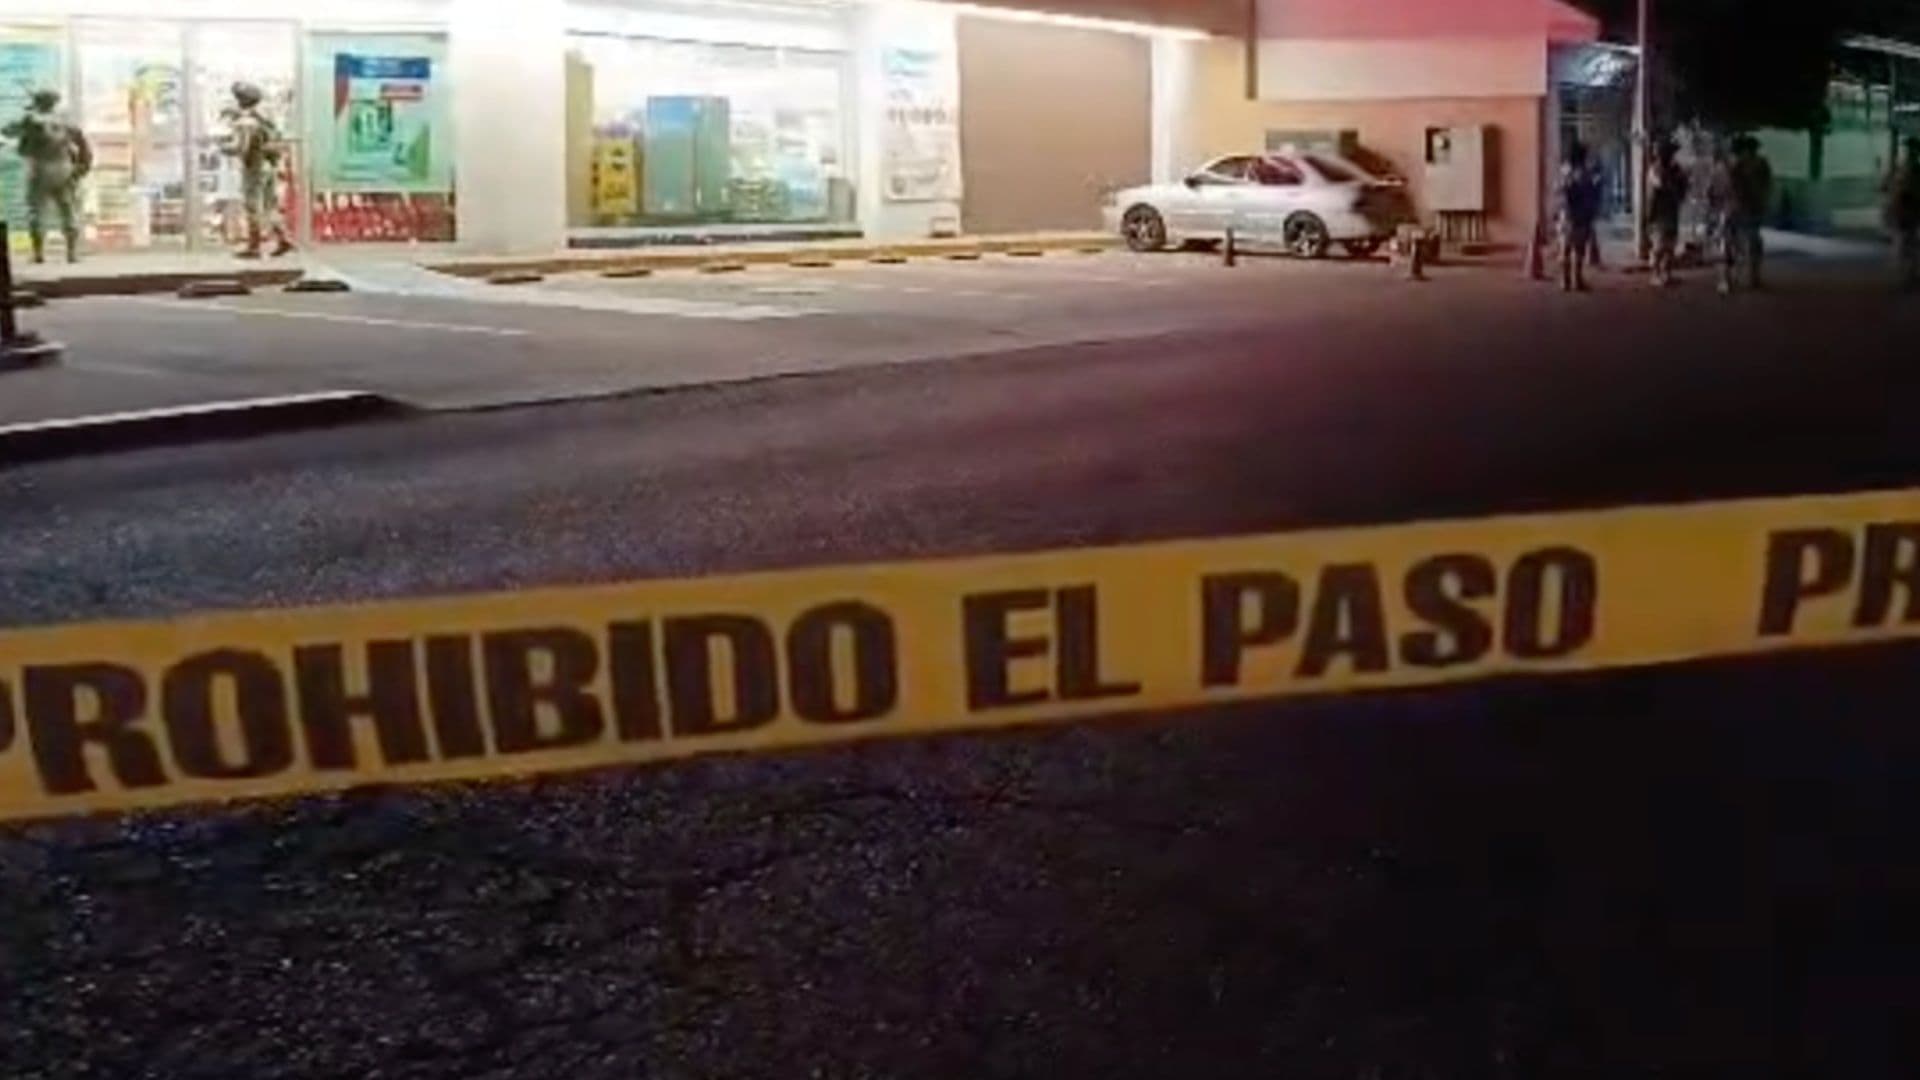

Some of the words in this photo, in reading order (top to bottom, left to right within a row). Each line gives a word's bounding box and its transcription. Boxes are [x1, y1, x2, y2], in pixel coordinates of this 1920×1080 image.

[0, 600, 897, 795] ROHIBIDO
[962, 584, 1140, 711] EL
[1201, 546, 1598, 687] PASO
